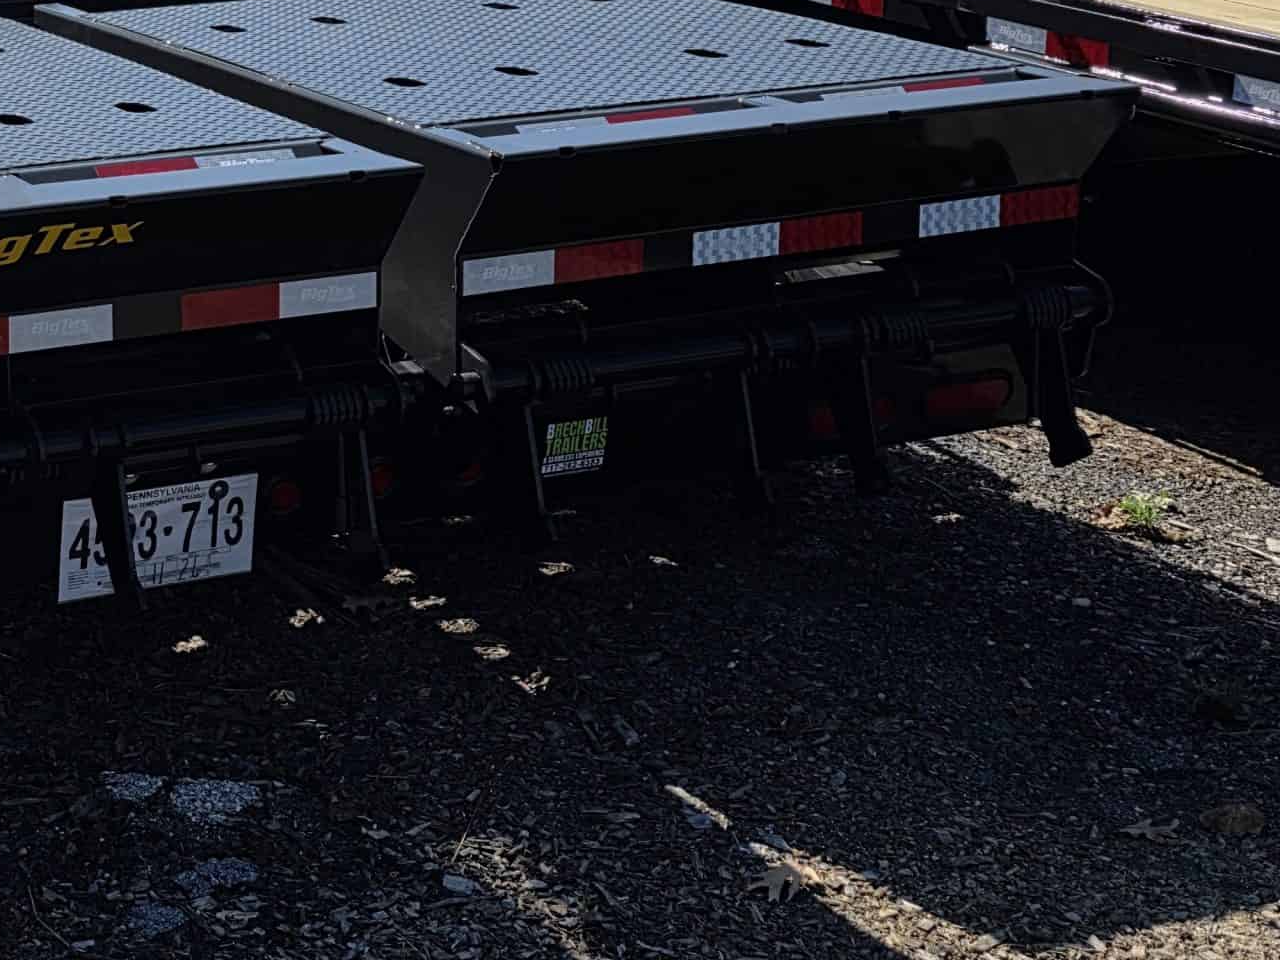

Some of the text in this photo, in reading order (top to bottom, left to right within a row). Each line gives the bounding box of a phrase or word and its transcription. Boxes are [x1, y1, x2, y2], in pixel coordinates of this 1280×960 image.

[546, 416, 609, 440] BRECHBILL
[544, 432, 607, 457] TRAILERS
[127, 483, 201, 501] PENNSYLVANIA
